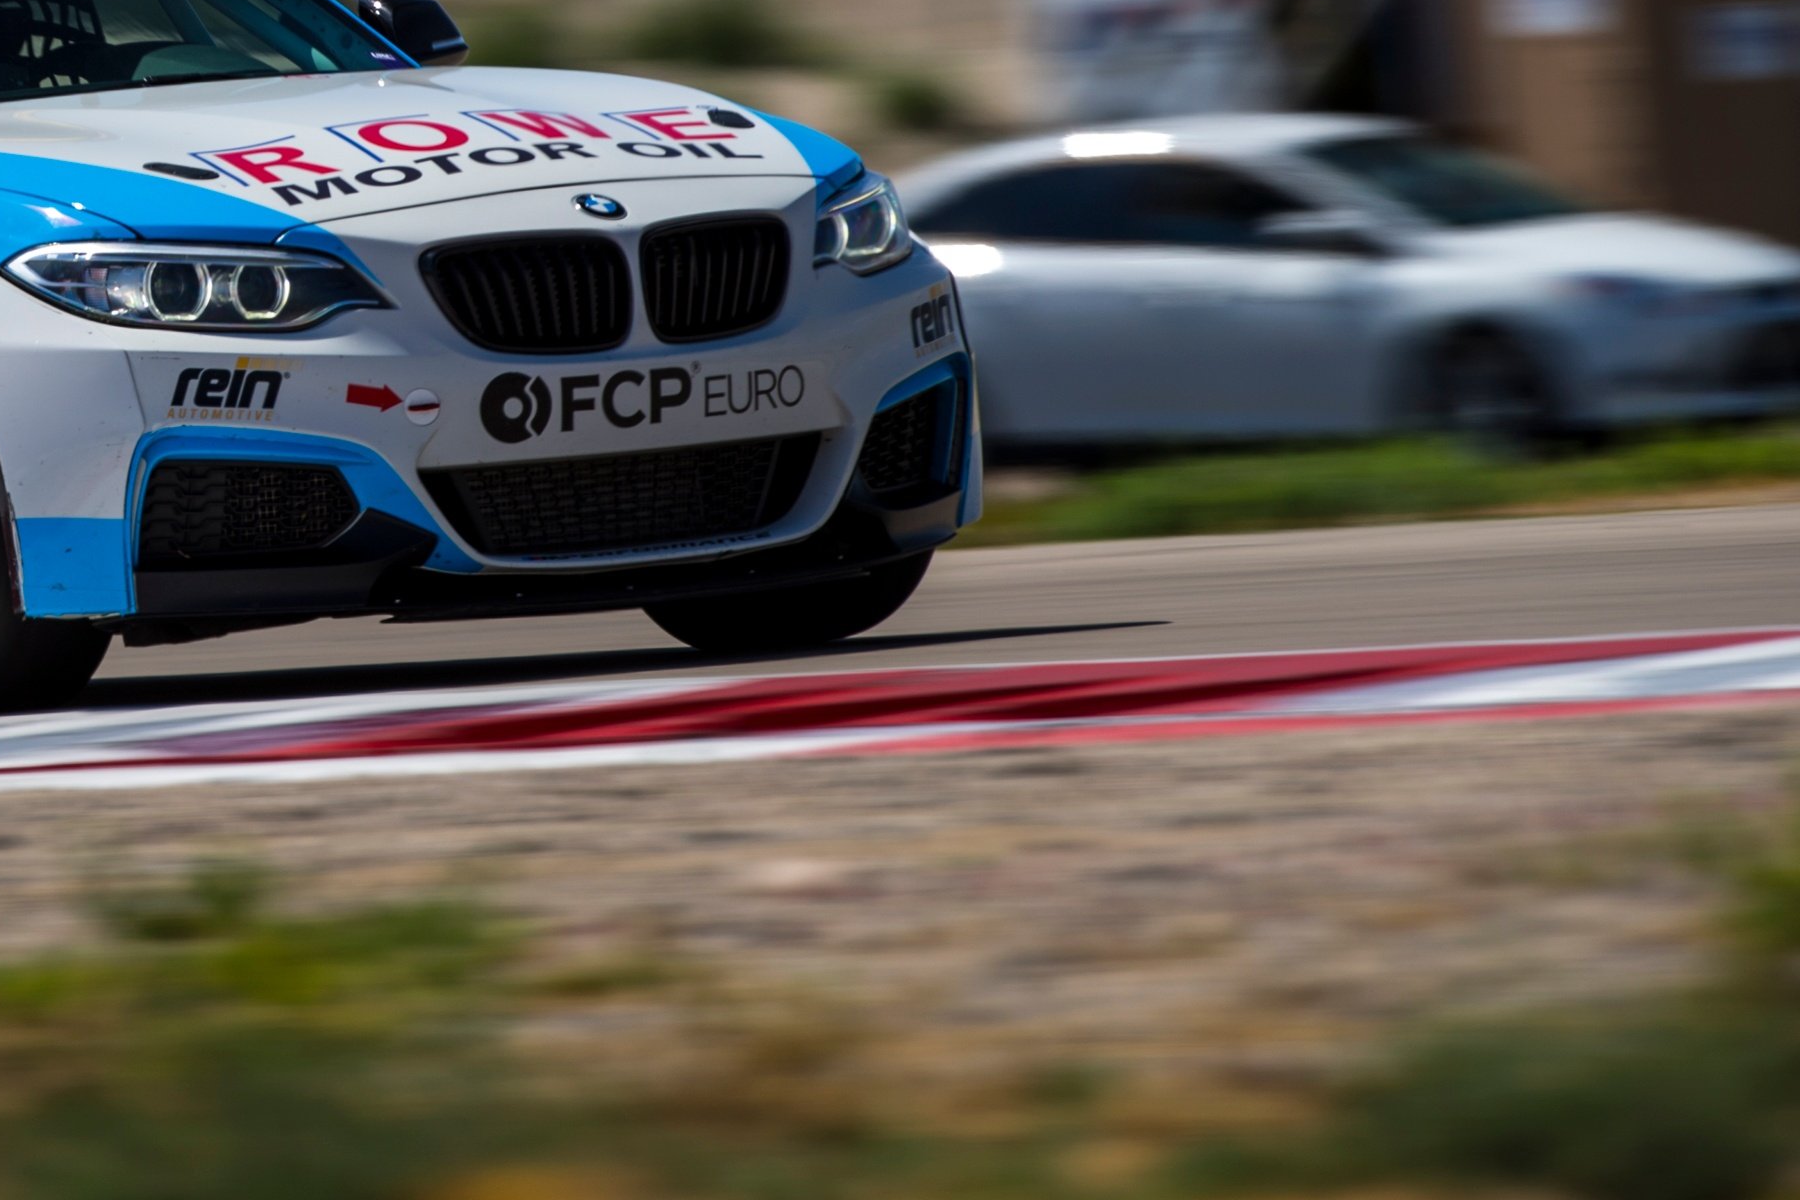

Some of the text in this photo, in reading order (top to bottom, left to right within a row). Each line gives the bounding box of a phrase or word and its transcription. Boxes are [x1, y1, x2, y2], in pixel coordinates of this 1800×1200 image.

[214, 109, 738, 184] ROWE
[271, 141, 765, 206] MOTOR OIL
[911, 287, 955, 349] rein
[170, 357, 283, 409] rein
[703, 364, 805, 418] EURO
[166, 408, 275, 422] AUTOMOTIVE
